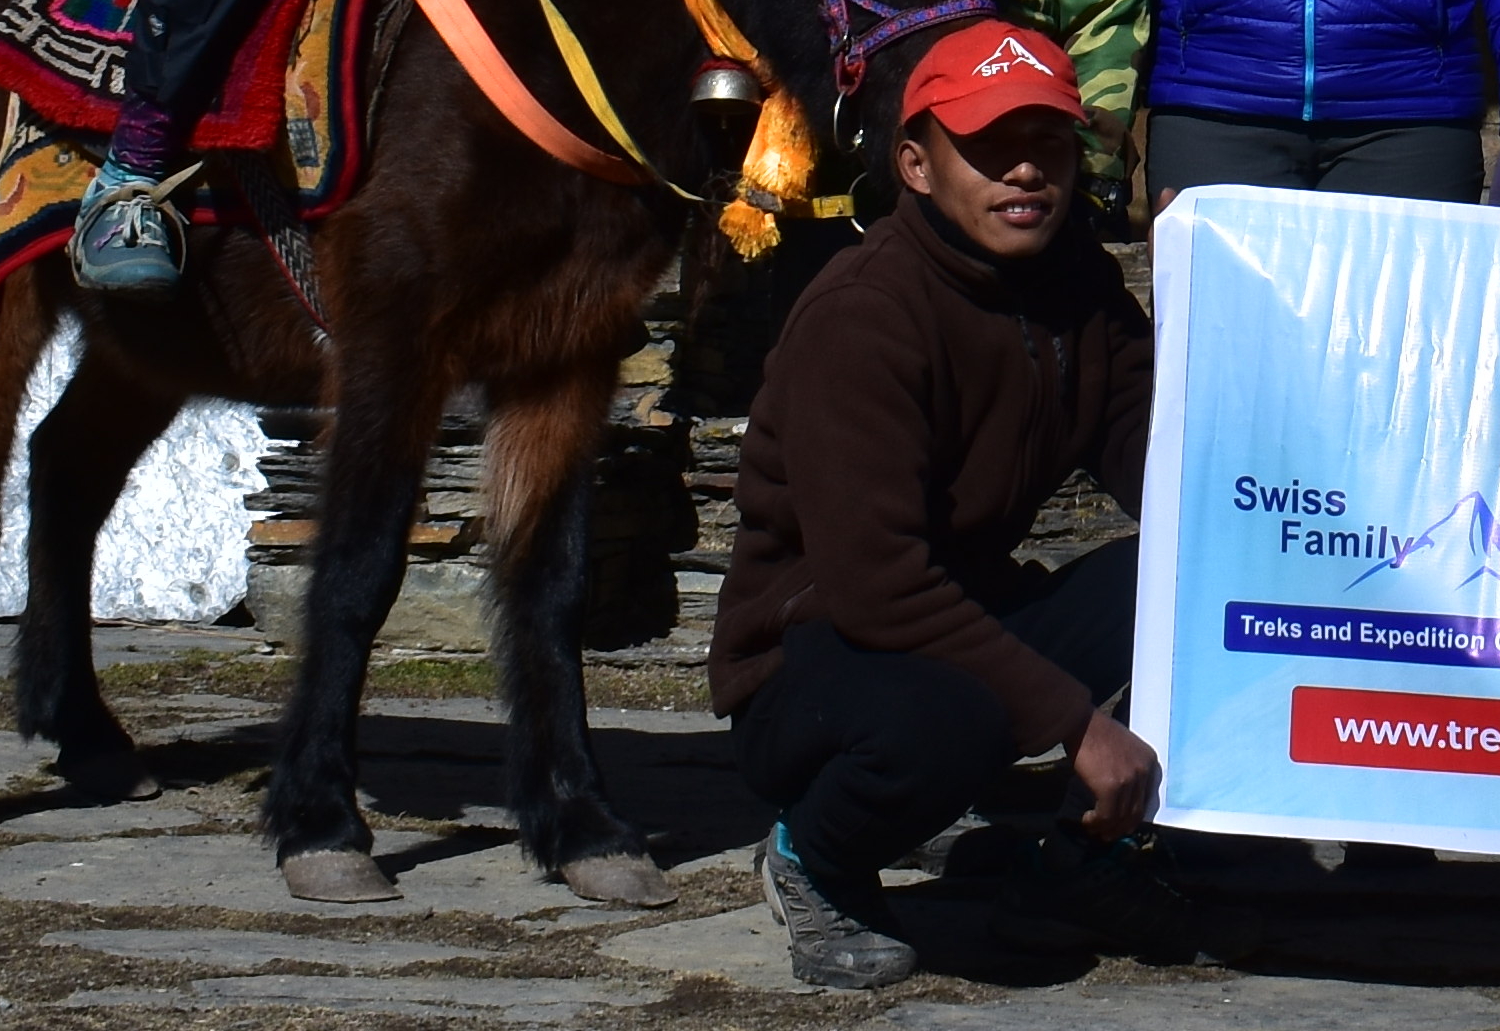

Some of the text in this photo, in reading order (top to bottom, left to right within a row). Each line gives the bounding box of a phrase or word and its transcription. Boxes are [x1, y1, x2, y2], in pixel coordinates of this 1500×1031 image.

[981, 62, 1010, 76] SFT
[1233, 475, 1347, 517] Swiss
[1281, 520, 1415, 568] Family
[1241, 614, 1302, 639] Treks
[1310, 620, 1352, 642] and
[1360, 622, 1486, 651] Expedition
